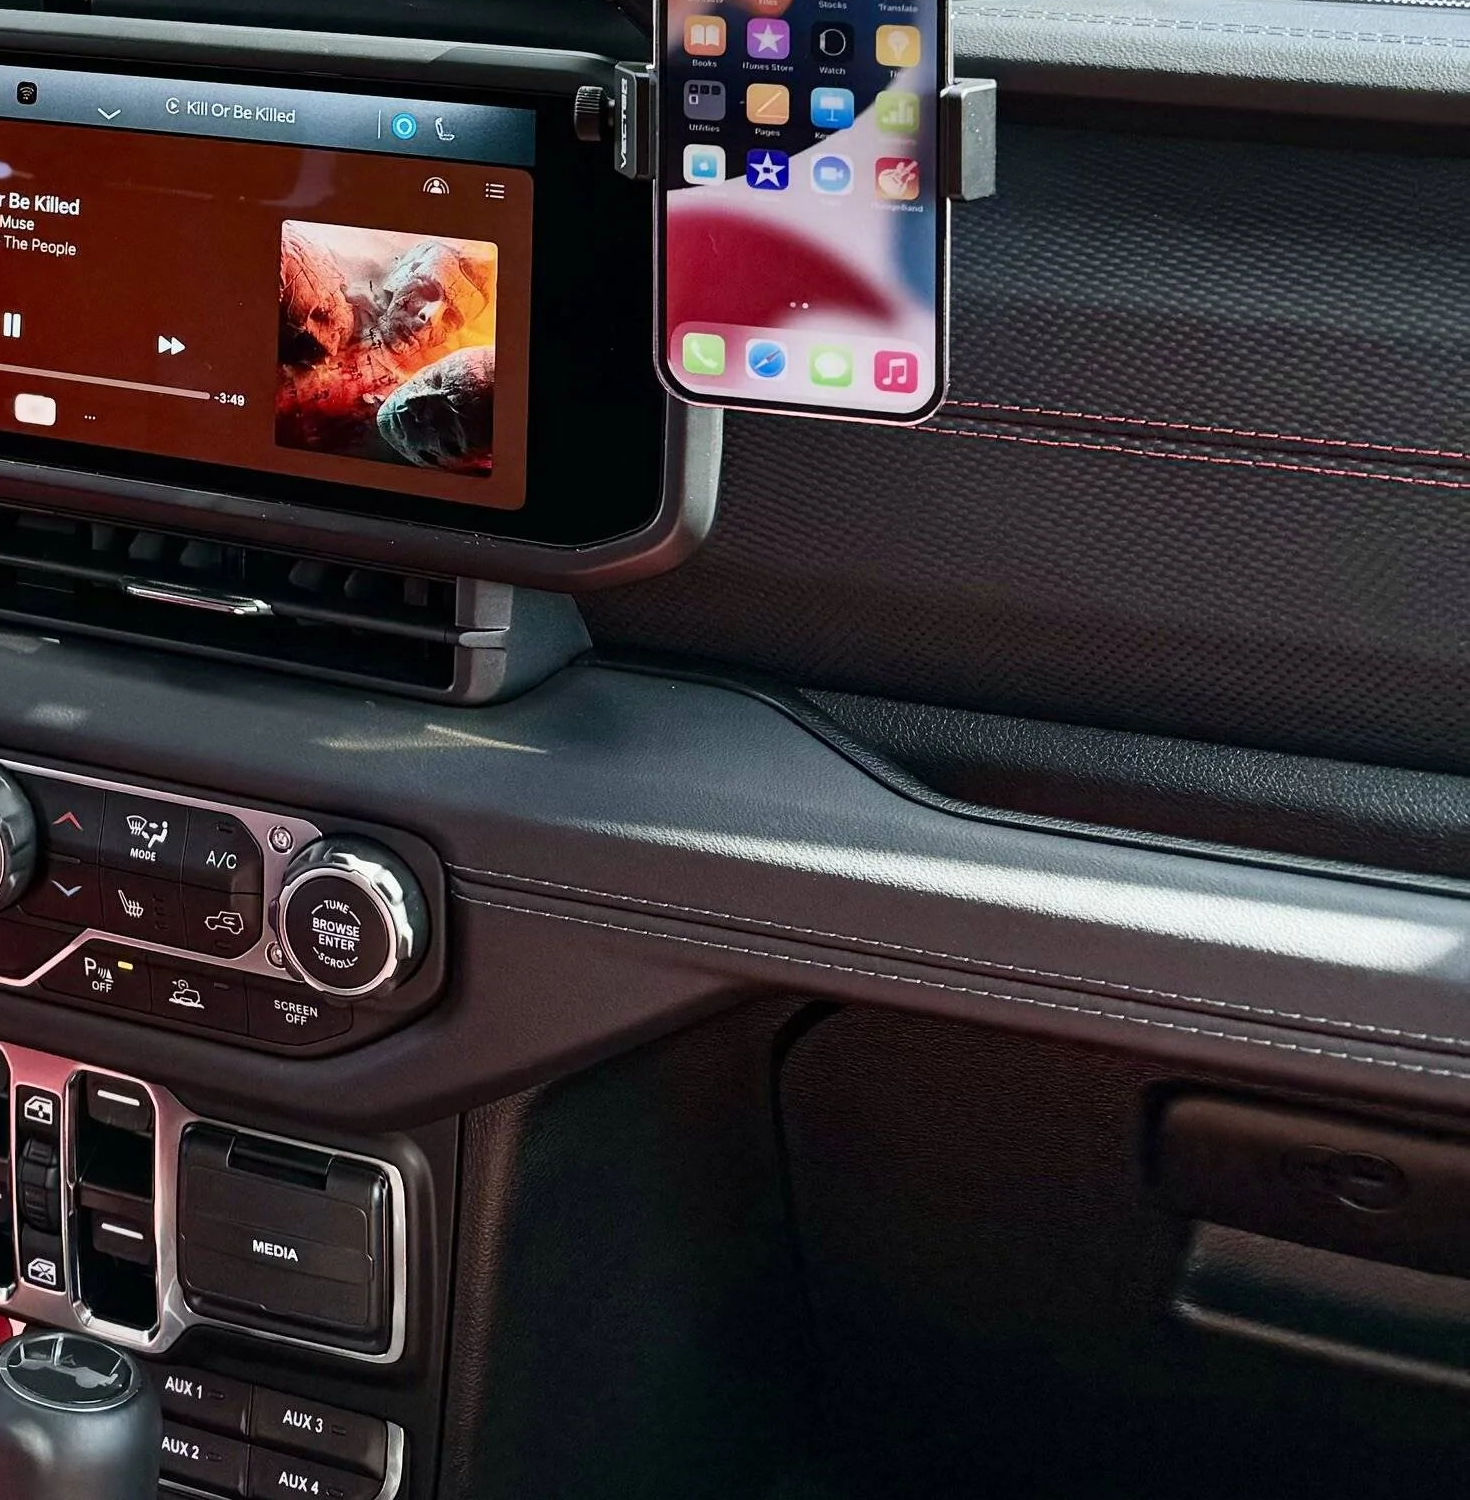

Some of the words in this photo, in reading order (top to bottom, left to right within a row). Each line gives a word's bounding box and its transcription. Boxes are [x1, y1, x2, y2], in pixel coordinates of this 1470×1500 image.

[818, 0, 848, 10] Stocks
[877, 2, 920, 13] Translate
[692, 59, 718, 68] Books
[771, 63, 794, 72] Store
[819, 65, 847, 76] Watch
[186, 101, 208, 116] Kill
[211, 103, 231, 118] Or
[233, 105, 252, 120] Be
[255, 107, 296, 124] Killed
[688, 123, 721, 133] Utilities
[754, 128, 781, 138] Pages
[8, 192, 30, 211] Be
[33, 195, 81, 216] Killed
[3, 234, 29, 252] The
[31, 239, 77, 257] People
[213, 392, 246, 407] -3:49
[129, 847, 158, 863] MODE
[205, 849, 238, 870] A/C
[324, 899, 350, 915] TUNE
[312, 916, 361, 938] BROWSE
[318, 934, 356, 952] ENTER
[317, 951, 356, 969] SCROLL
[91, 979, 113, 994] OFF
[273, 998, 320, 1018] SCREEN
[285, 1012, 308, 1026] OFF
[252, 1239, 299, 1263] MEDIA
[164, 1376, 193, 1398] AUX
[195, 1384, 203, 1400] 1
[282, 1409, 312, 1430] AUX
[314, 1417, 324, 1433] 3
[161, 1436, 189, 1458] AUX
[190, 1445, 200, 1461] 2
[278, 1470, 308, 1493] AUX
[309, 1479, 320, 1495] 4
